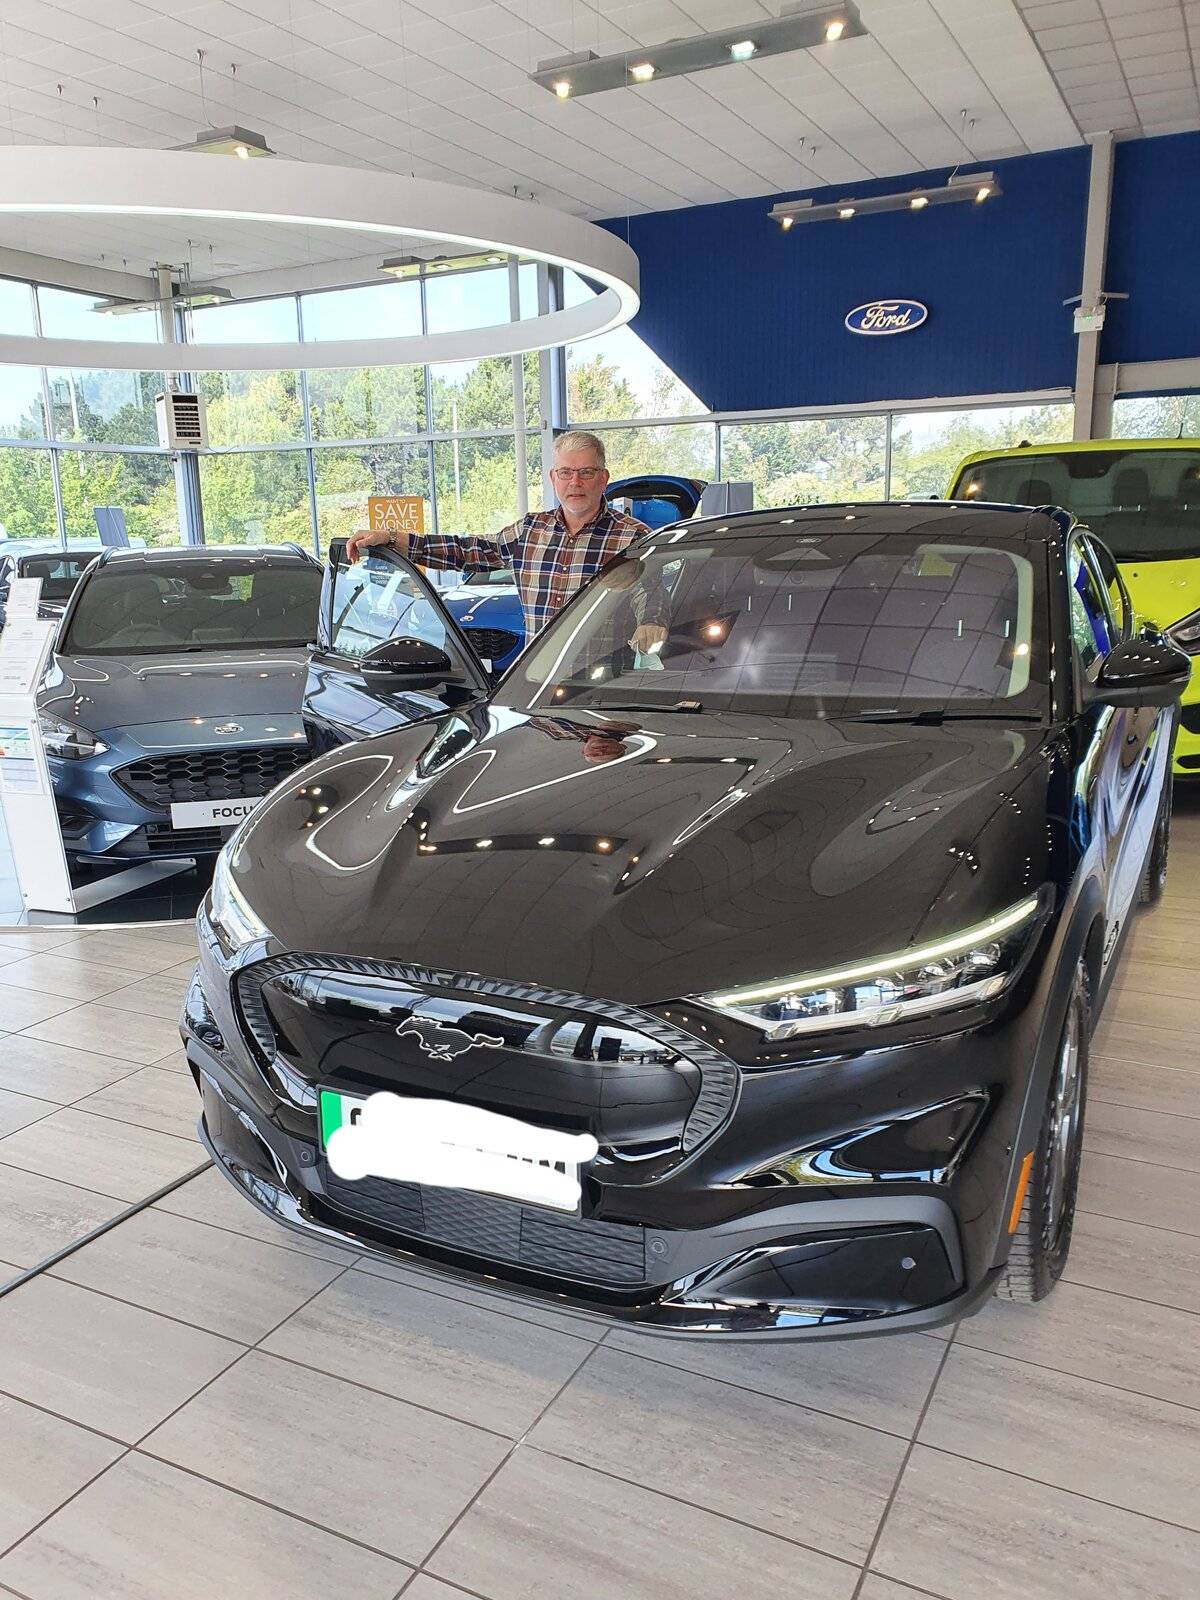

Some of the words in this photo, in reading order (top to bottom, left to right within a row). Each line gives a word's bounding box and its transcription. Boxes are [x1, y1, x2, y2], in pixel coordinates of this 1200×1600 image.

[861, 303, 912, 329] Ford
[374, 503, 419, 520] SAVE
[375, 519, 418, 530] MONEY
